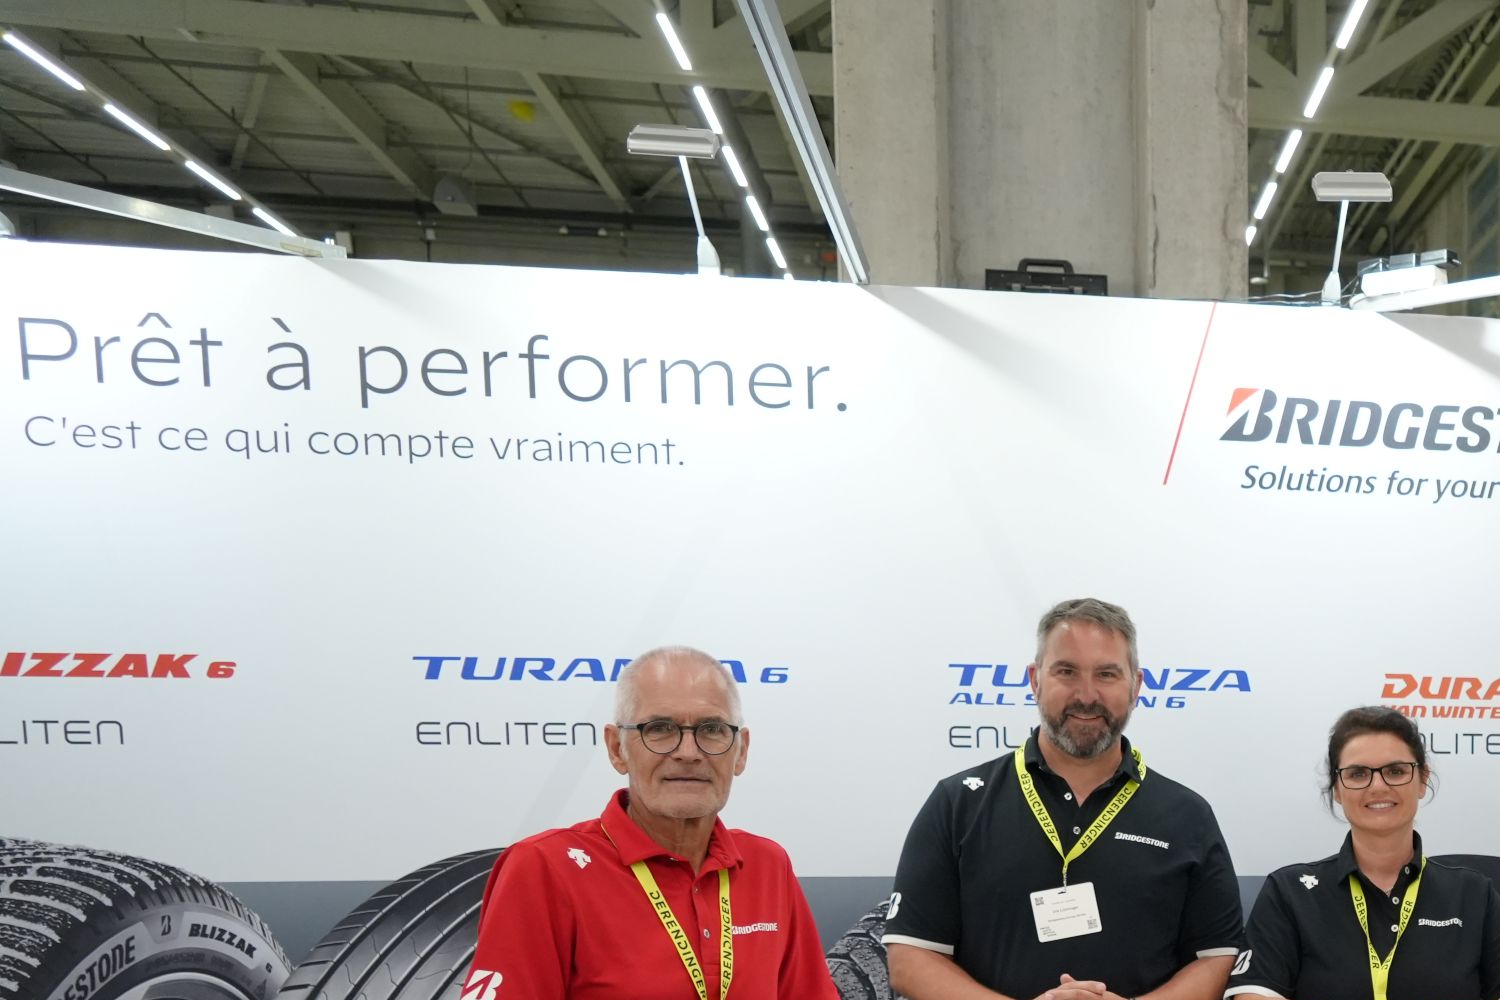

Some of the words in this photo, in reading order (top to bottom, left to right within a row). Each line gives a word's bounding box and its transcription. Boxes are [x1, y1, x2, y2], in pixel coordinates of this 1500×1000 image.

[17, 312, 223, 389] Prêt
[265, 317, 311, 392] à
[358, 334, 849, 413] performer.
[24, 415, 142, 451] C'est
[157, 426, 209, 453] ce
[225, 422, 291, 463] qui
[308, 426, 475, 464] compte
[489, 433, 686, 467] vraiment.
[1241, 465, 1377, 494] Solutions
[1387, 470, 1428, 498] for
[1432, 479, 1500, 504] your
[206, 661, 237, 679] 6
[412, 656, 747, 684] TURAA
[760, 667, 789, 684] 6
[948, 663, 1252, 692] TUNZA
[948, 692, 1016, 706] ALL
[1165, 696, 1186, 708] 6
[416, 721, 596, 746] ENLITEN
[1079, 787, 1132, 849] DERENDINGER
[1114, 831, 1170, 850] BRIDGESTONE
[188, 923, 257, 959] BLIZZAK
